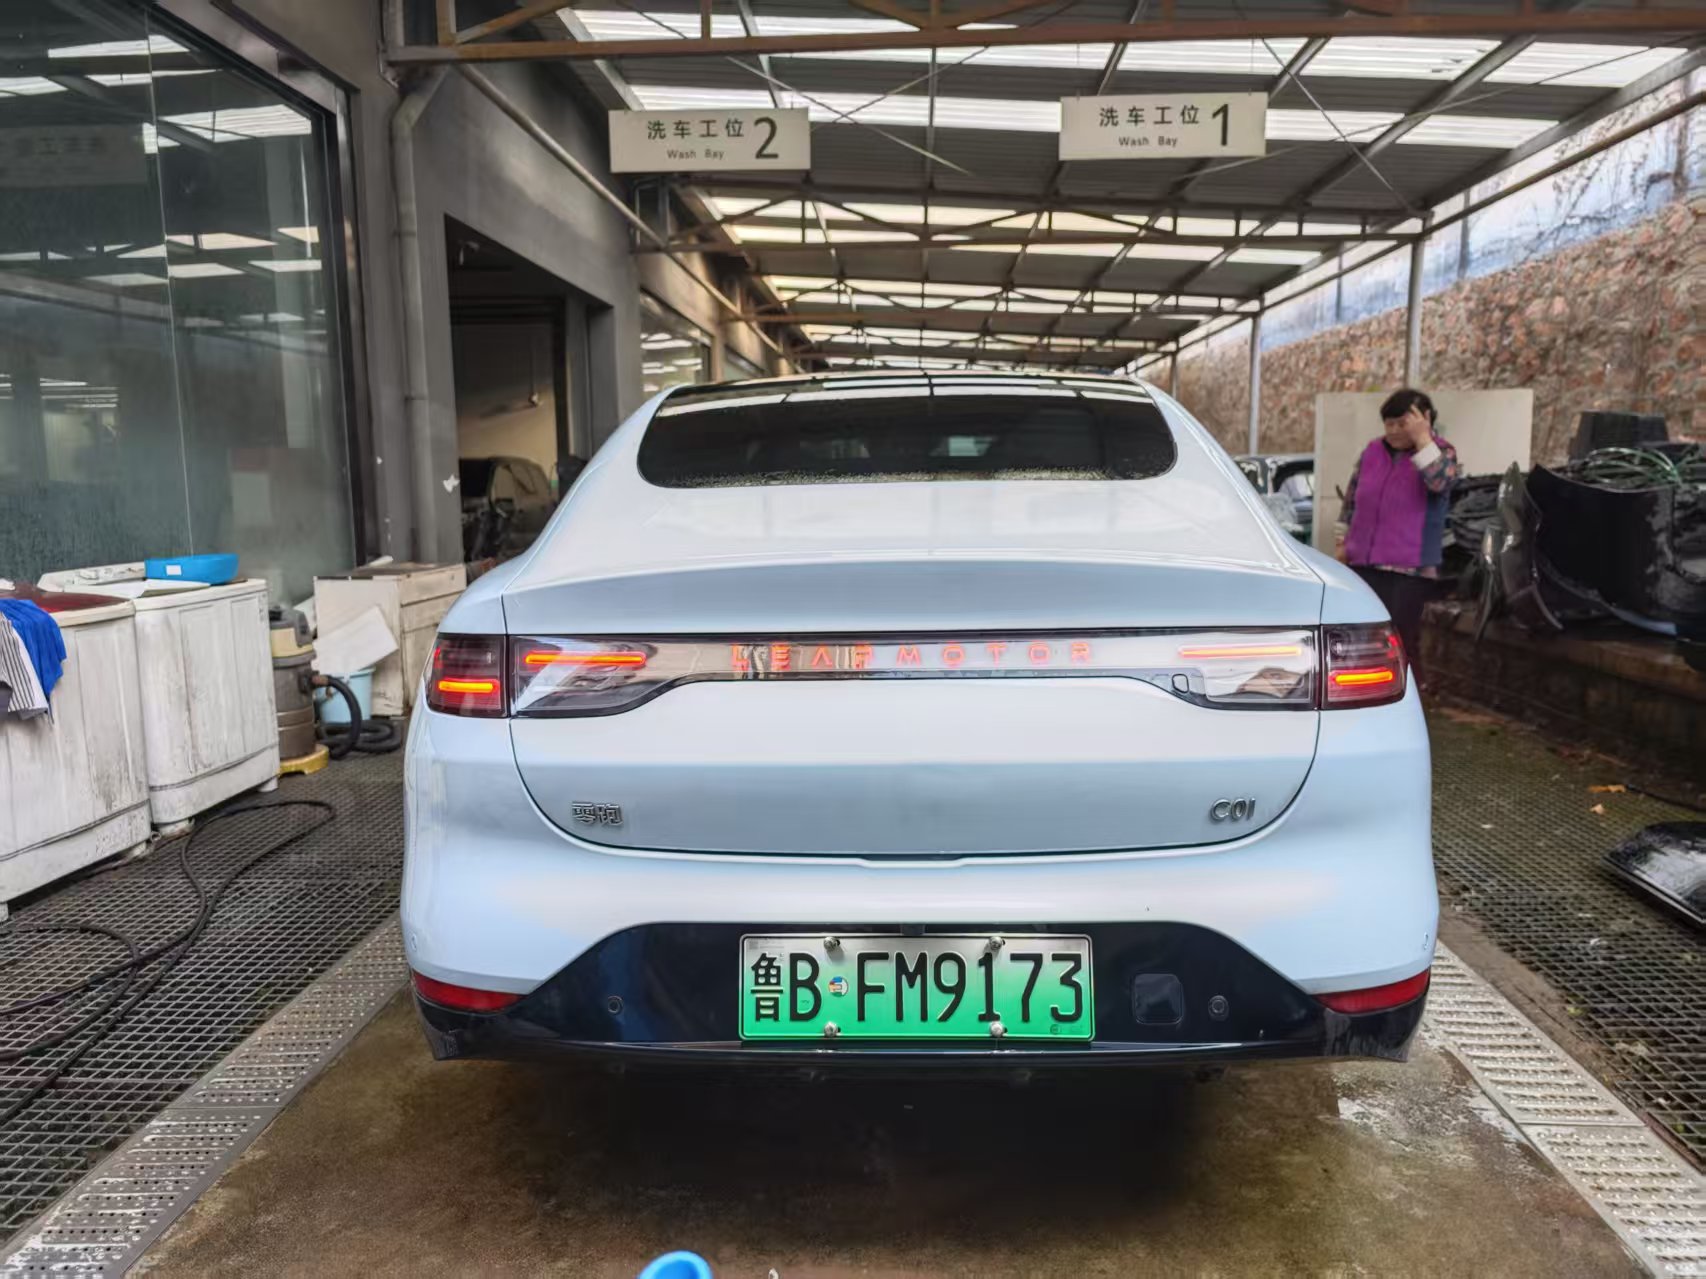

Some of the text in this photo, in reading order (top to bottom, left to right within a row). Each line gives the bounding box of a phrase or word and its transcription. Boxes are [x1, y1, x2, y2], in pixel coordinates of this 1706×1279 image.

[1099, 103, 1230, 147] 洗车工位 1
[647, 116, 780, 160] 洗车工位 2
[1118, 135, 1178, 148] Wash Bay
[667, 148, 725, 161] Wash Bay
[1210, 797, 1256, 822] C01
